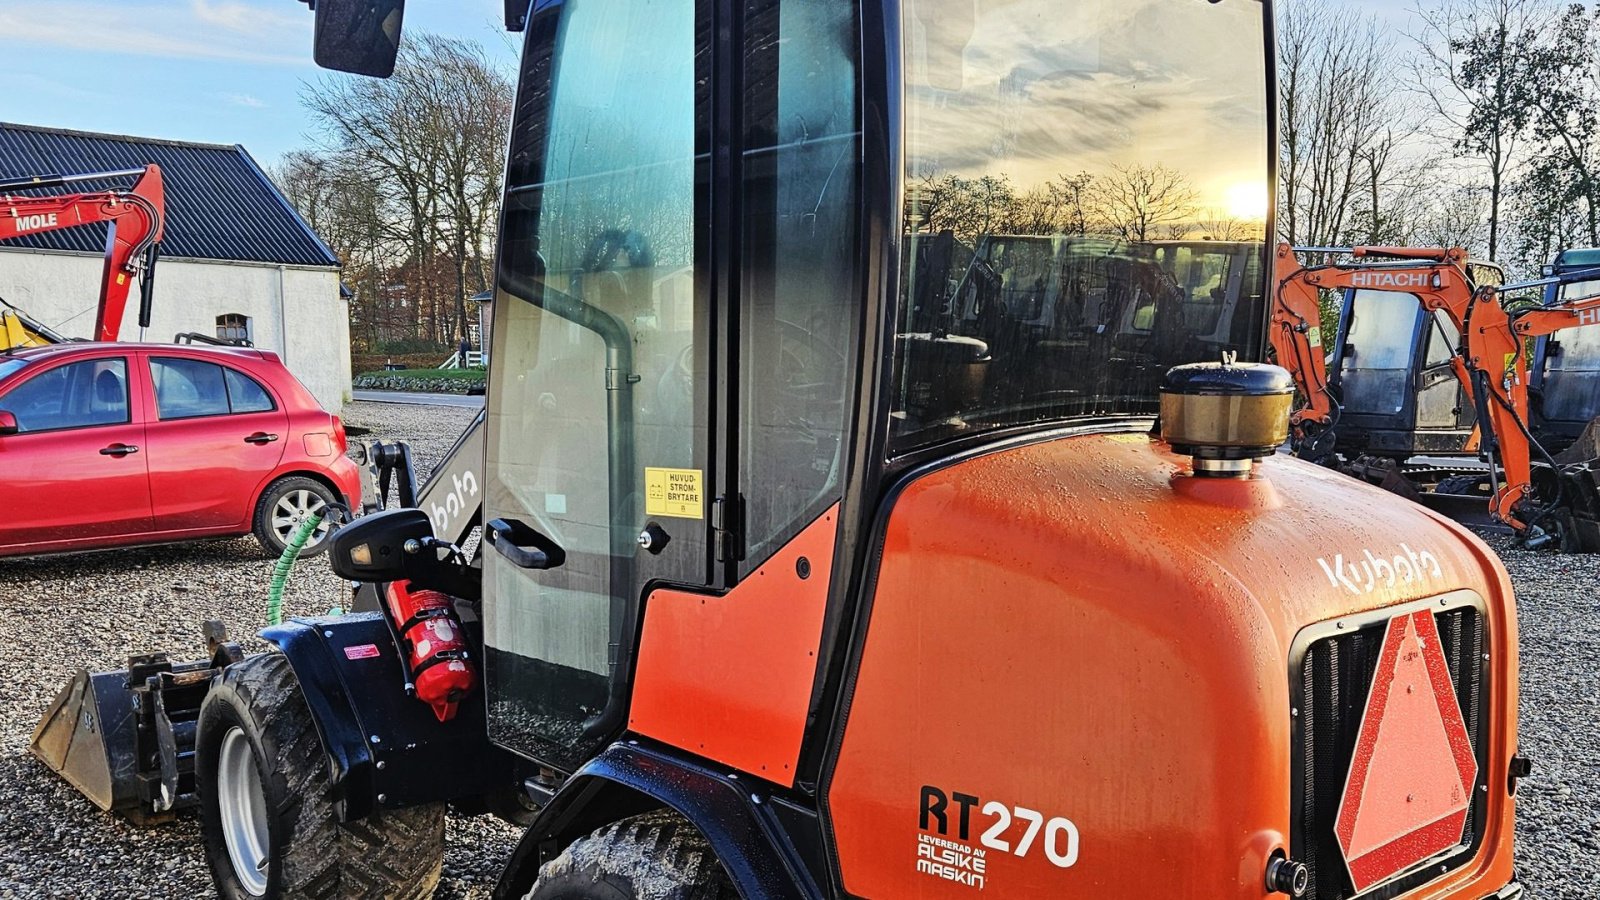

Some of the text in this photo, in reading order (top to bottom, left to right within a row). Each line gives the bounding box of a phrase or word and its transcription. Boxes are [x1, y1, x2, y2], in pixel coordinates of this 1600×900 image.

[15, 213, 57, 232] MOLE
[1351, 272, 1430, 287] HITACHI
[669, 473, 696, 483] HUVUD-
[667, 492, 699, 502] BRYTARE
[1316, 542, 1443, 595] Kubota
[918, 833, 986, 858] LEVERERAD AV
[917, 842, 987, 874] ALSIKE
[916, 858, 985, 890] MASKIN
